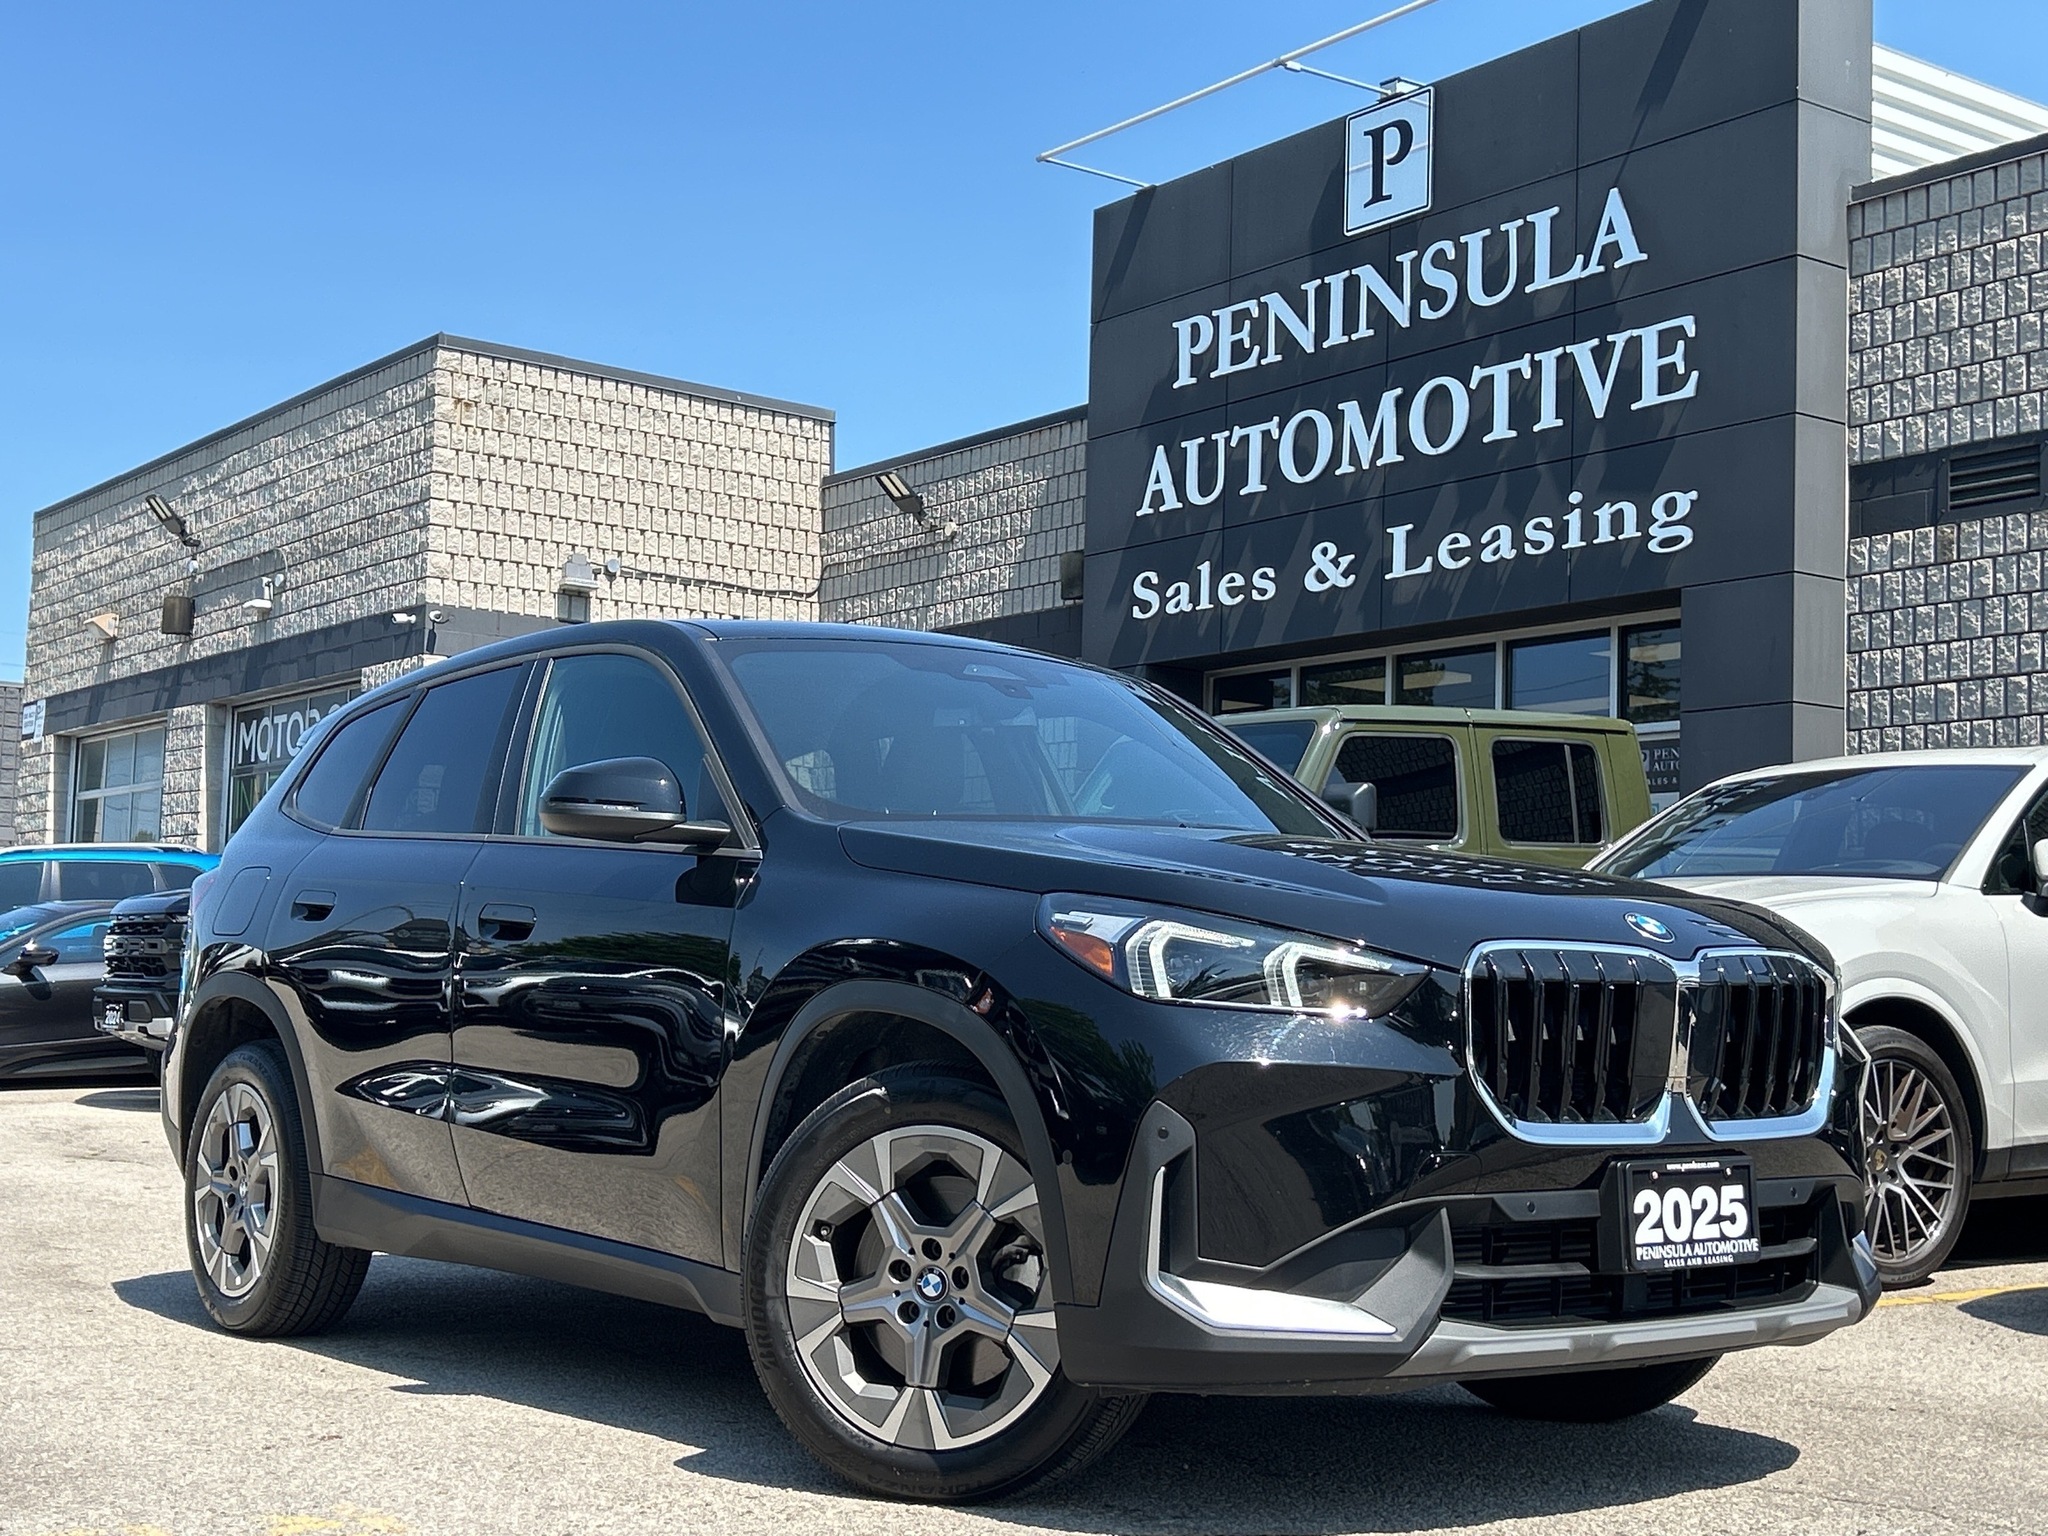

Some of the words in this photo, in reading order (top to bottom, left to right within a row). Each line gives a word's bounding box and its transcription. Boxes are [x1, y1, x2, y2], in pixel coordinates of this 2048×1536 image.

[1363, 118, 1414, 209] P
[1172, 187, 1649, 390] PENINSULA
[1135, 314, 1700, 517] AUTOMOTIVE
[1132, 561, 1277, 620] Sales
[1304, 542, 1356, 594] &
[1384, 490, 1699, 581] Leasing
[1634, 1185, 1748, 1244] 2025
[1636, 1243, 1693, 1261] PENINSULA
[1693, 1238, 1759, 1256] AUTOMOTIVE
[1664, 1258, 1685, 1268] SALES
[1687, 1257, 1702, 1266] AND
[1704, 1254, 1734, 1265] LEASING
